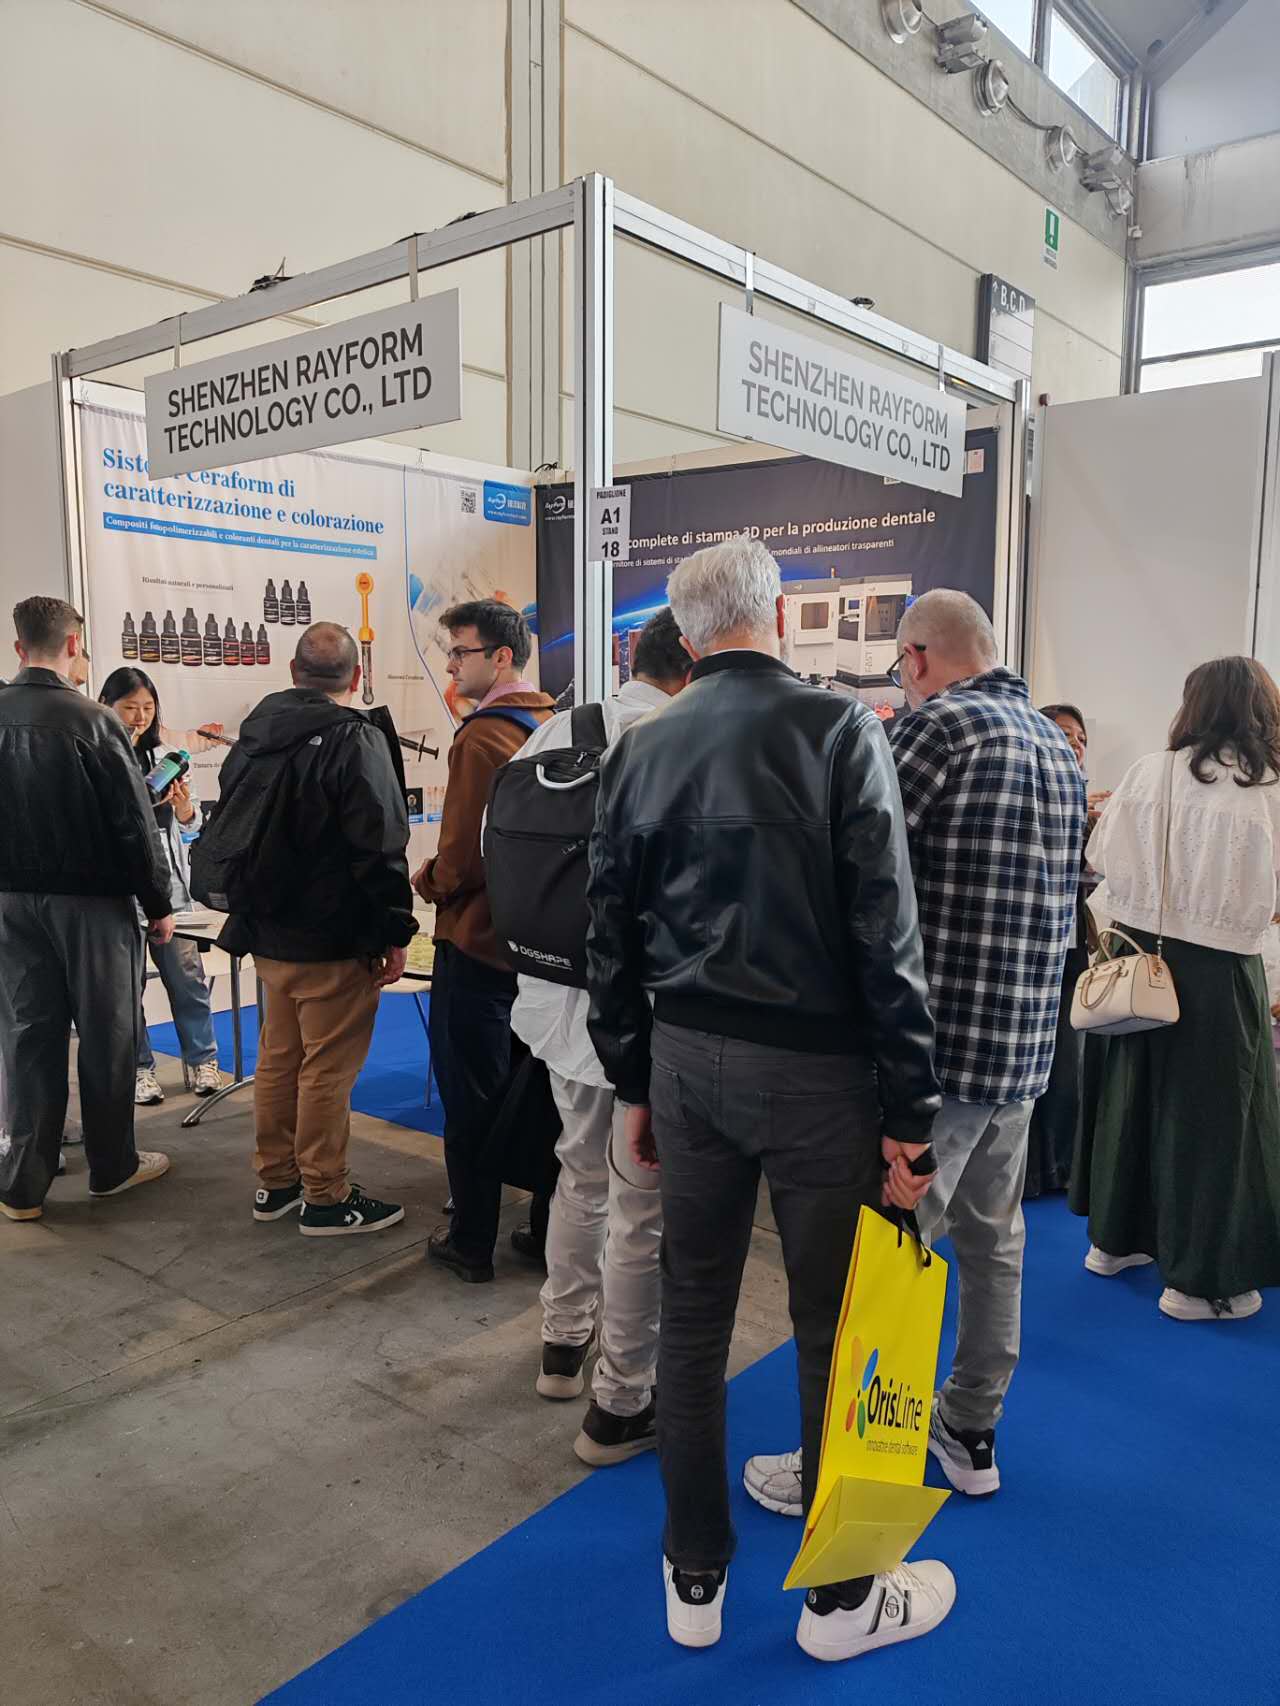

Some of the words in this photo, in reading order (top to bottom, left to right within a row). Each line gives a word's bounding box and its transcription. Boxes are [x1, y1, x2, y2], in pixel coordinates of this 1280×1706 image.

[168, 360, 289, 418] SHENZHEN
[296, 323, 423, 387] RAYFORM
[748, 340, 864, 411] SHENZHEN
[869, 384, 948, 439] RAYFORM
[164, 391, 318, 454] TECHNOLOGY
[324, 383, 373, 419] CO.,
[381, 366, 432, 408] LTD
[741, 378, 884, 452] TECHNOLOGY
[887, 429, 918, 468] CO.,
[922, 439, 951, 472] LTD
[104, 481, 272, 521] caratterizzazione
[277, 510, 286, 522] e
[292, 508, 384, 534] colorazione
[278, 480, 295, 497] di
[597, 489, 626, 499] PADIGLIONE
[601, 507, 620, 524] A1
[682, 532, 693, 544] di
[743, 526, 760, 538] 3D
[763, 525, 785, 540] per
[788, 522, 799, 535] la
[803, 516, 877, 537] produzione
[881, 508, 936, 527] dentale
[602, 541, 620, 558] 18
[804, 545, 811, 554] di
[851, 539, 894, 551] trasparenti
[867, 1375, 923, 1431] OrisLine
